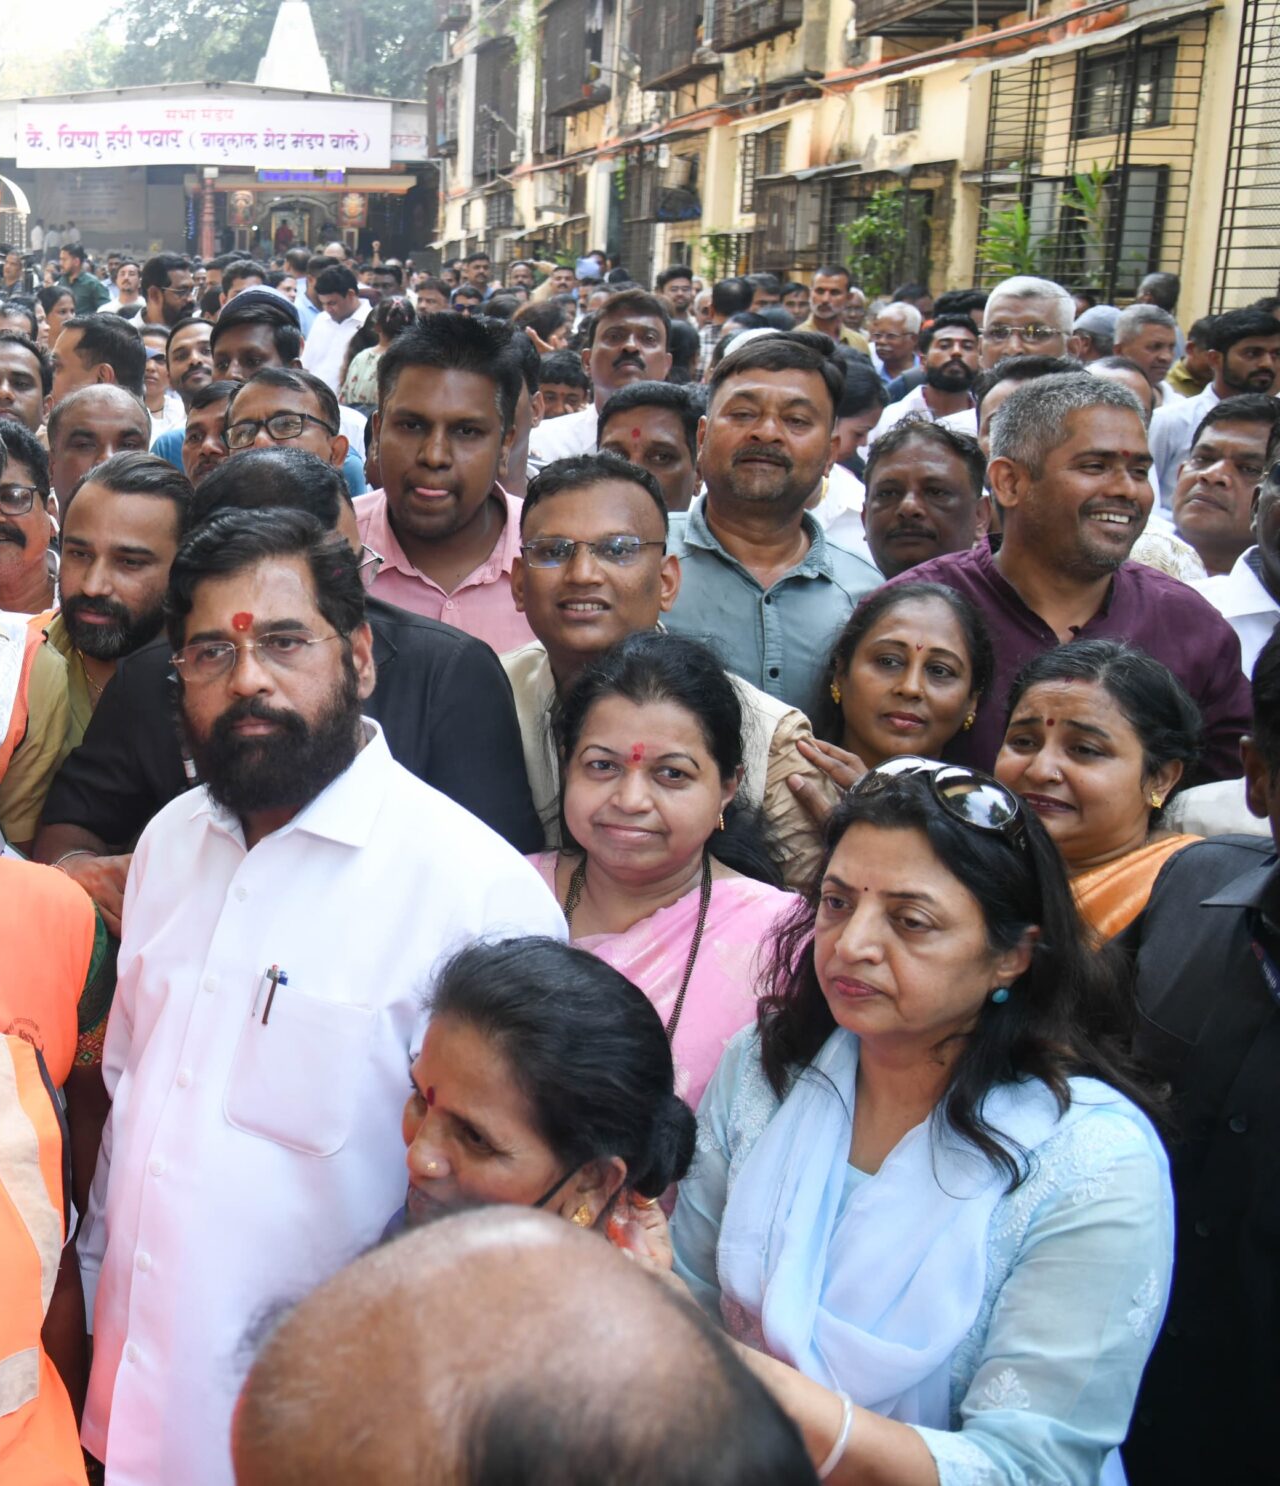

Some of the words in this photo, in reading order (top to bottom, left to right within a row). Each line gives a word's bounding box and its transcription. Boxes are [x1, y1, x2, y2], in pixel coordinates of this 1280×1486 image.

[57, 124, 103, 159] विष्णु
[105, 124, 132, 150] हरी
[137, 130, 183, 148] पवार
[290, 128, 325, 150] मंडप
